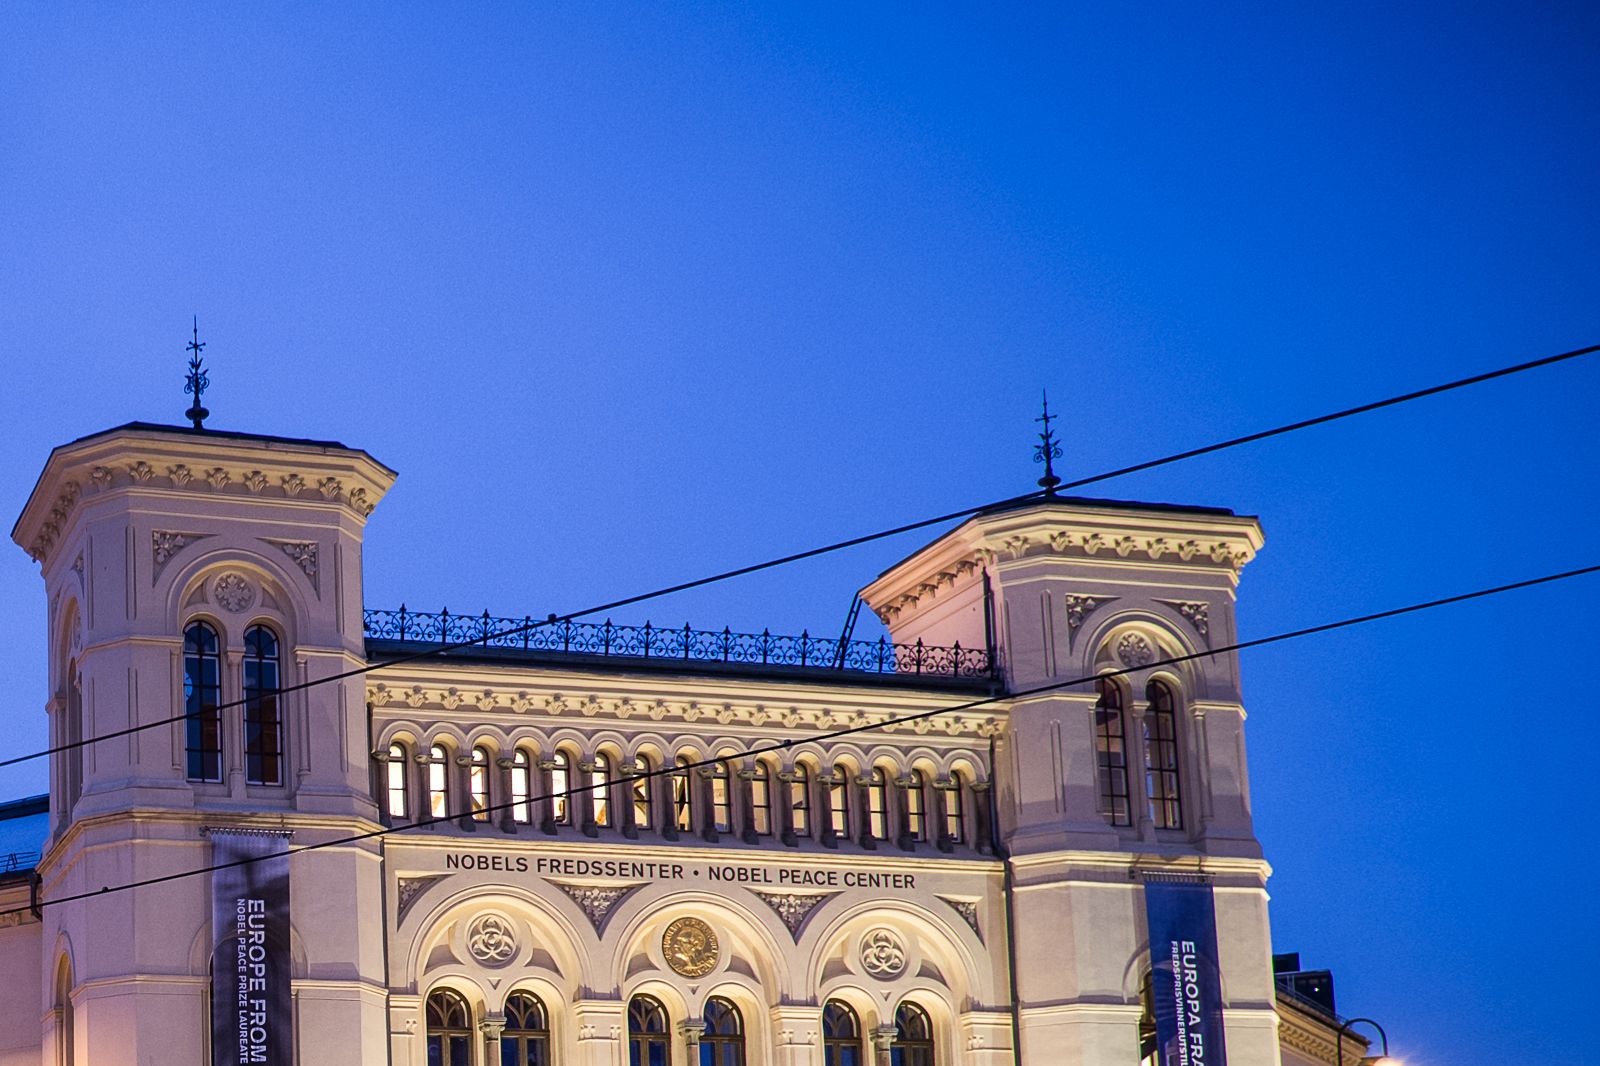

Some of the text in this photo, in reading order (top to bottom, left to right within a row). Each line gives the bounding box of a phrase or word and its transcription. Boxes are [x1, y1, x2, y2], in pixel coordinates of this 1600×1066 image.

[446, 853, 684, 880] NOBELS FREDSSENTER
[708, 866, 916, 889] NOBEL PEACE CENTER
[237, 898, 246, 935] NOBEL
[238, 937, 247, 972] PEACE
[248, 899, 266, 992] EUROPE
[238, 975, 248, 1007] PRIZE
[1181, 940, 1201, 1026] EUROPA
[238, 1009, 249, 1064] LAUREATE
[250, 999, 267, 1062] FROM
